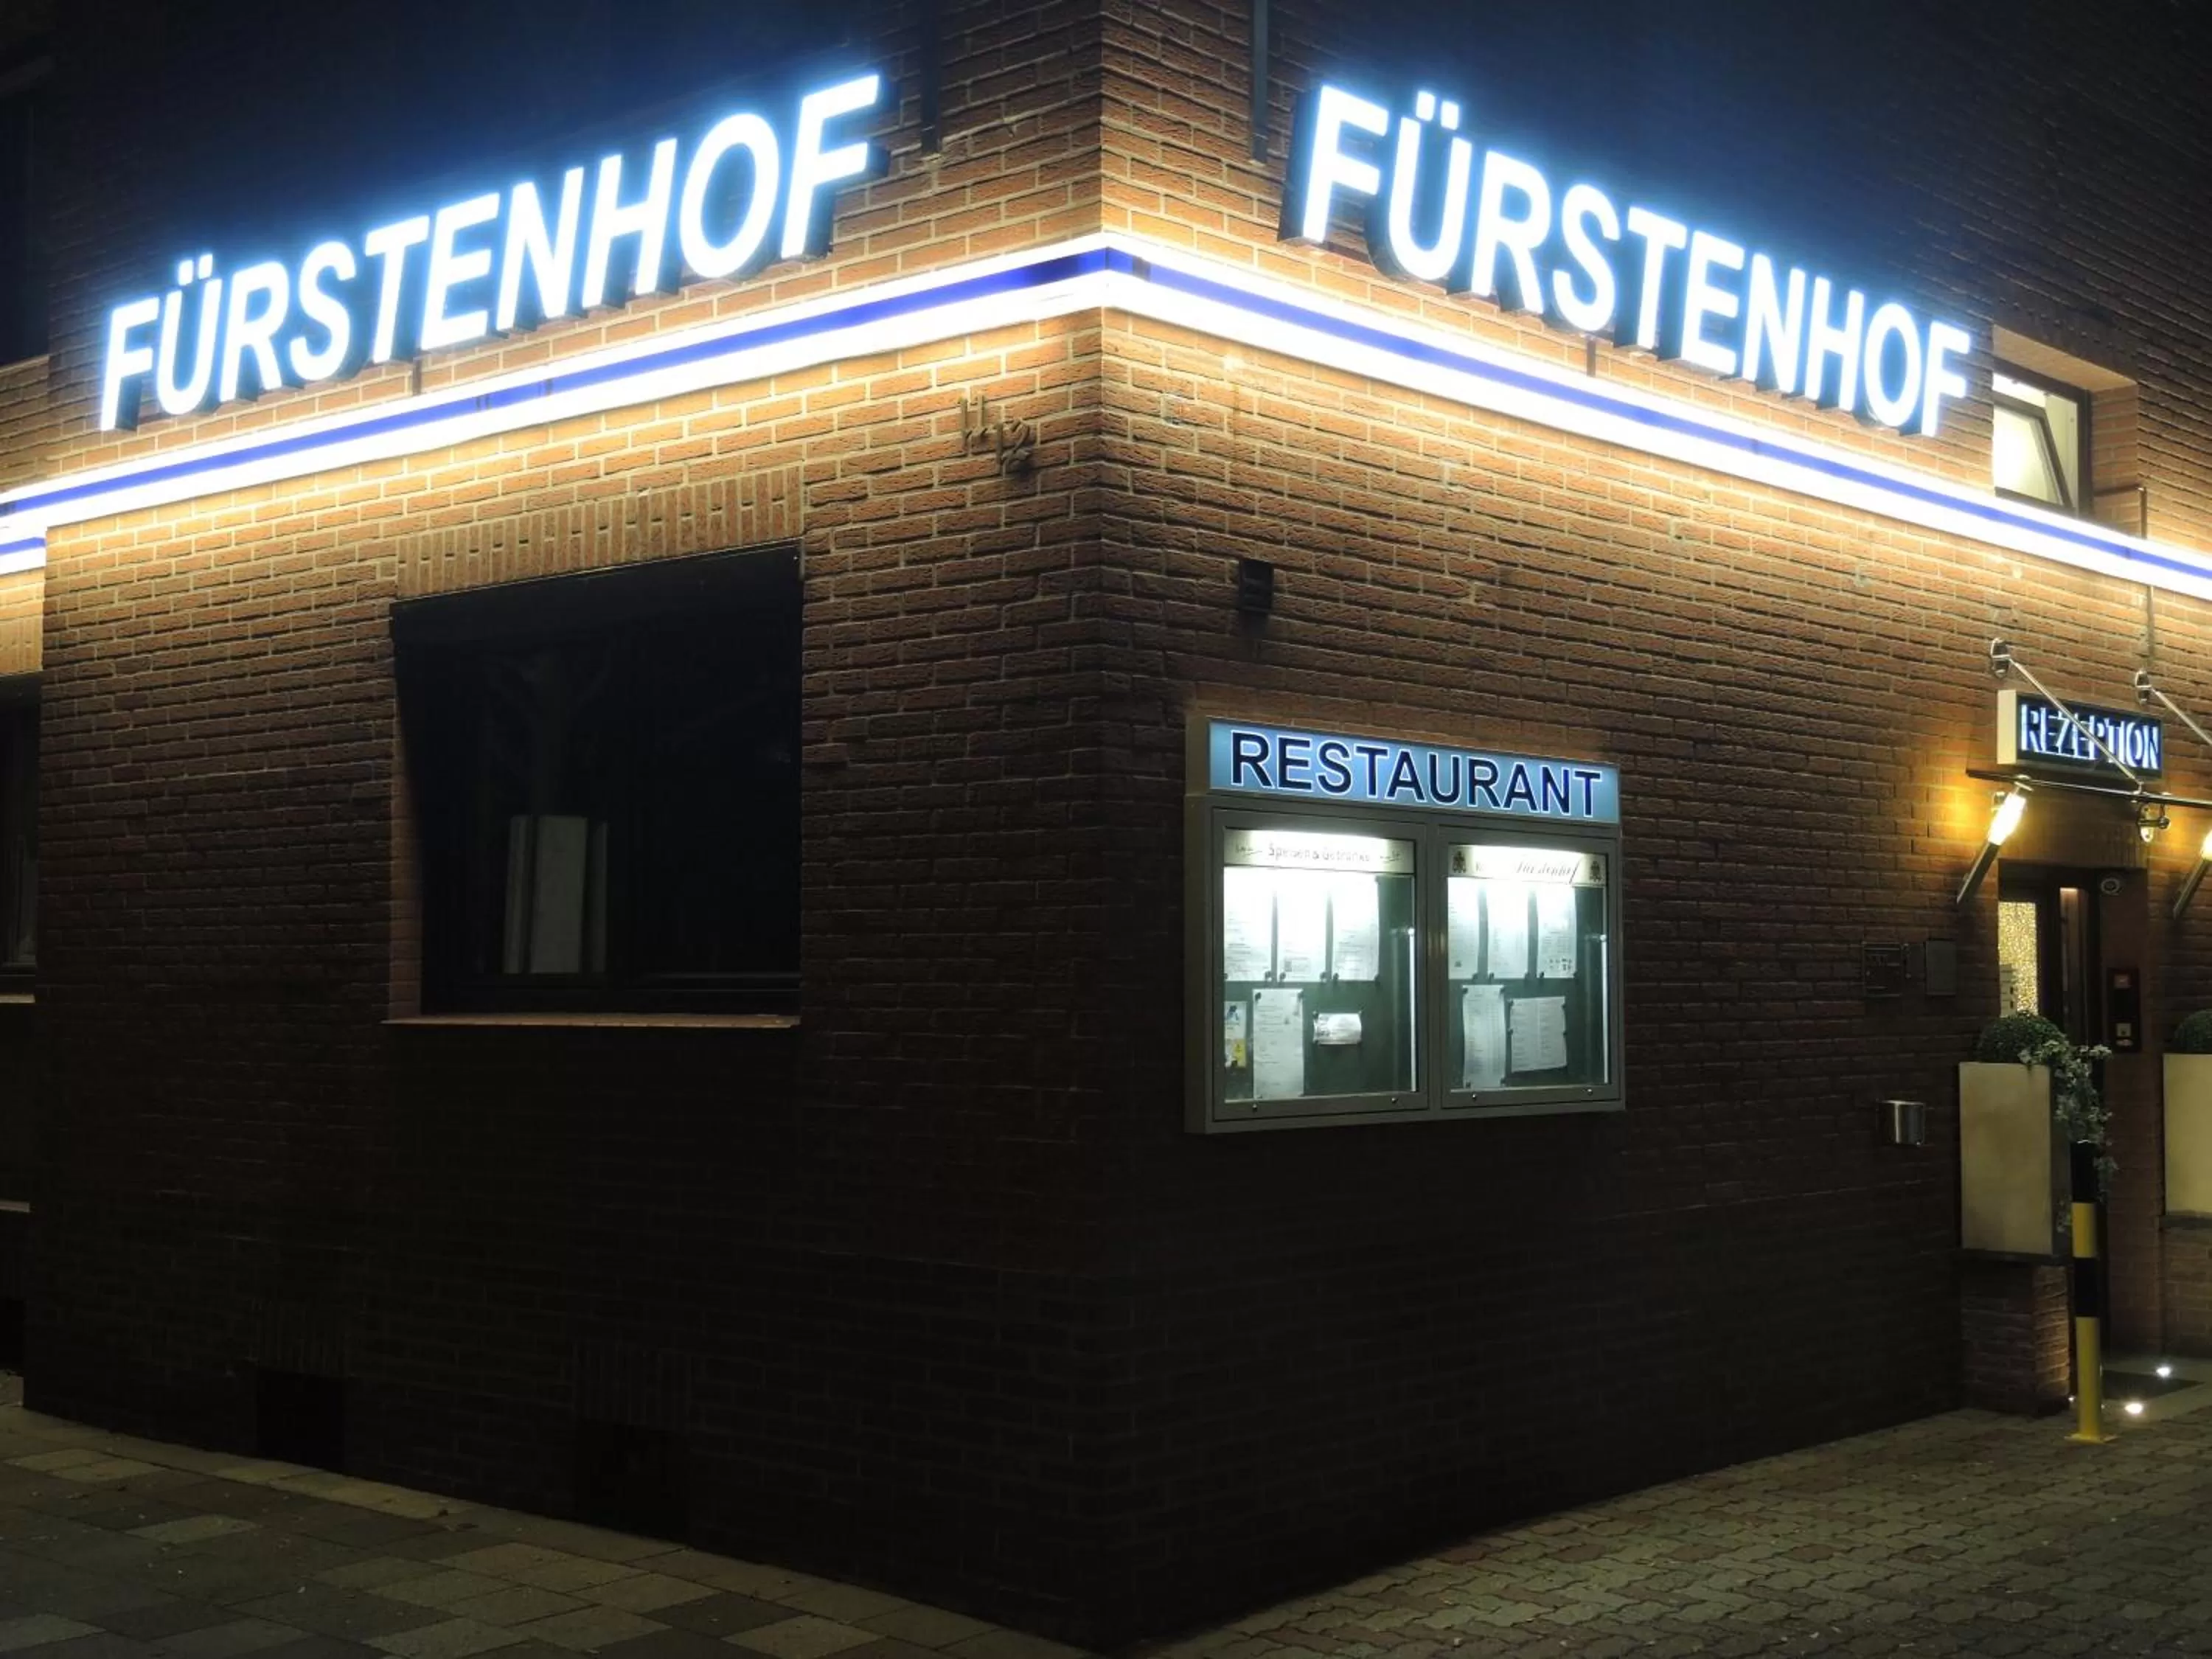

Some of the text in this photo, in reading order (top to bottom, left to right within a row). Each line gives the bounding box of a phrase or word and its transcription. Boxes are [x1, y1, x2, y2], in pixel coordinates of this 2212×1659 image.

[99, 72, 880, 432] FÜRSTENHOF
[1299, 83, 1971, 437] FÜRSTENHOF
[1230, 729, 1602, 817] RESTAURANT
[2020, 703, 2160, 770] REZEPTION
